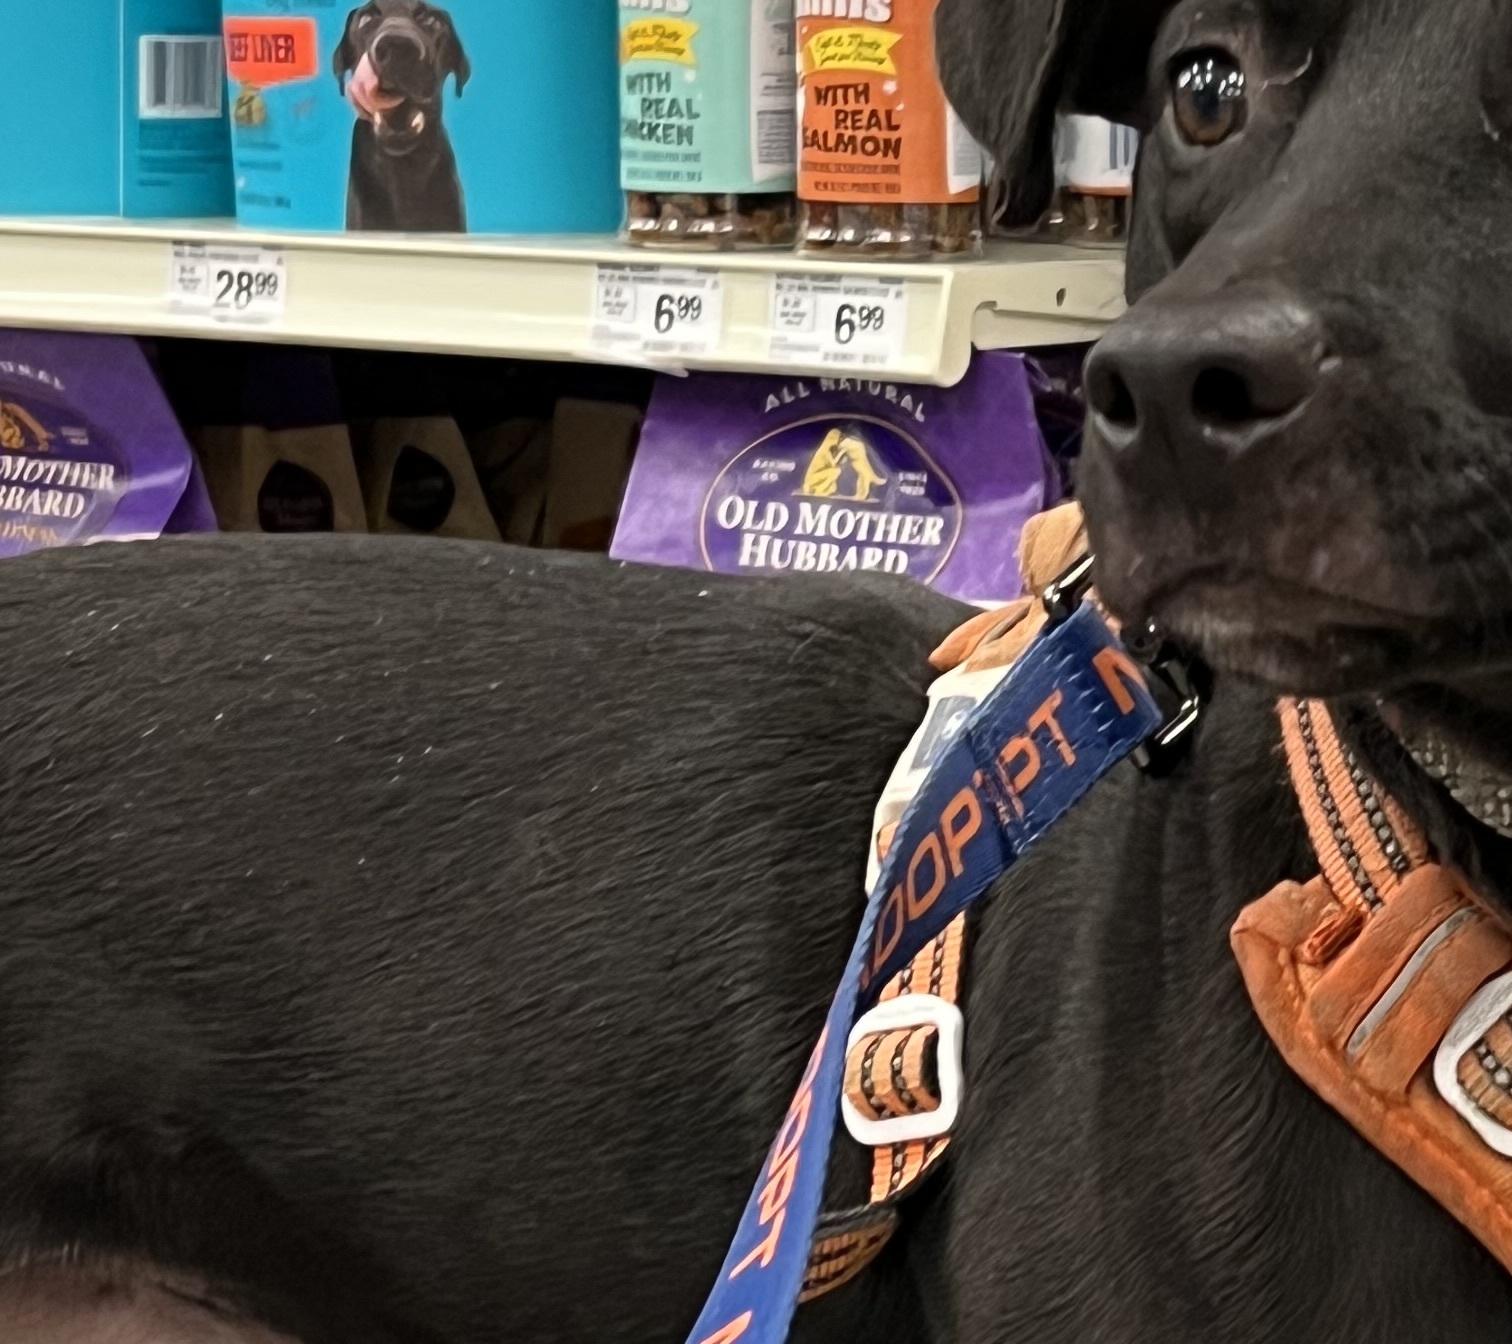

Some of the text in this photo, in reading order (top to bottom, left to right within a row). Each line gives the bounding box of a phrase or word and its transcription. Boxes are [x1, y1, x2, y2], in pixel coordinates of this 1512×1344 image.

[625, 70, 671, 96] WITH
[814, 82, 870, 107] WITH
[641, 97, 701, 120] REAL
[834, 108, 902, 132] REAL
[764, 377, 926, 423] ALL NATURAL
[717, 495, 945, 546] OLD MOTHER
[738, 533, 910, 575] HUBBARD
